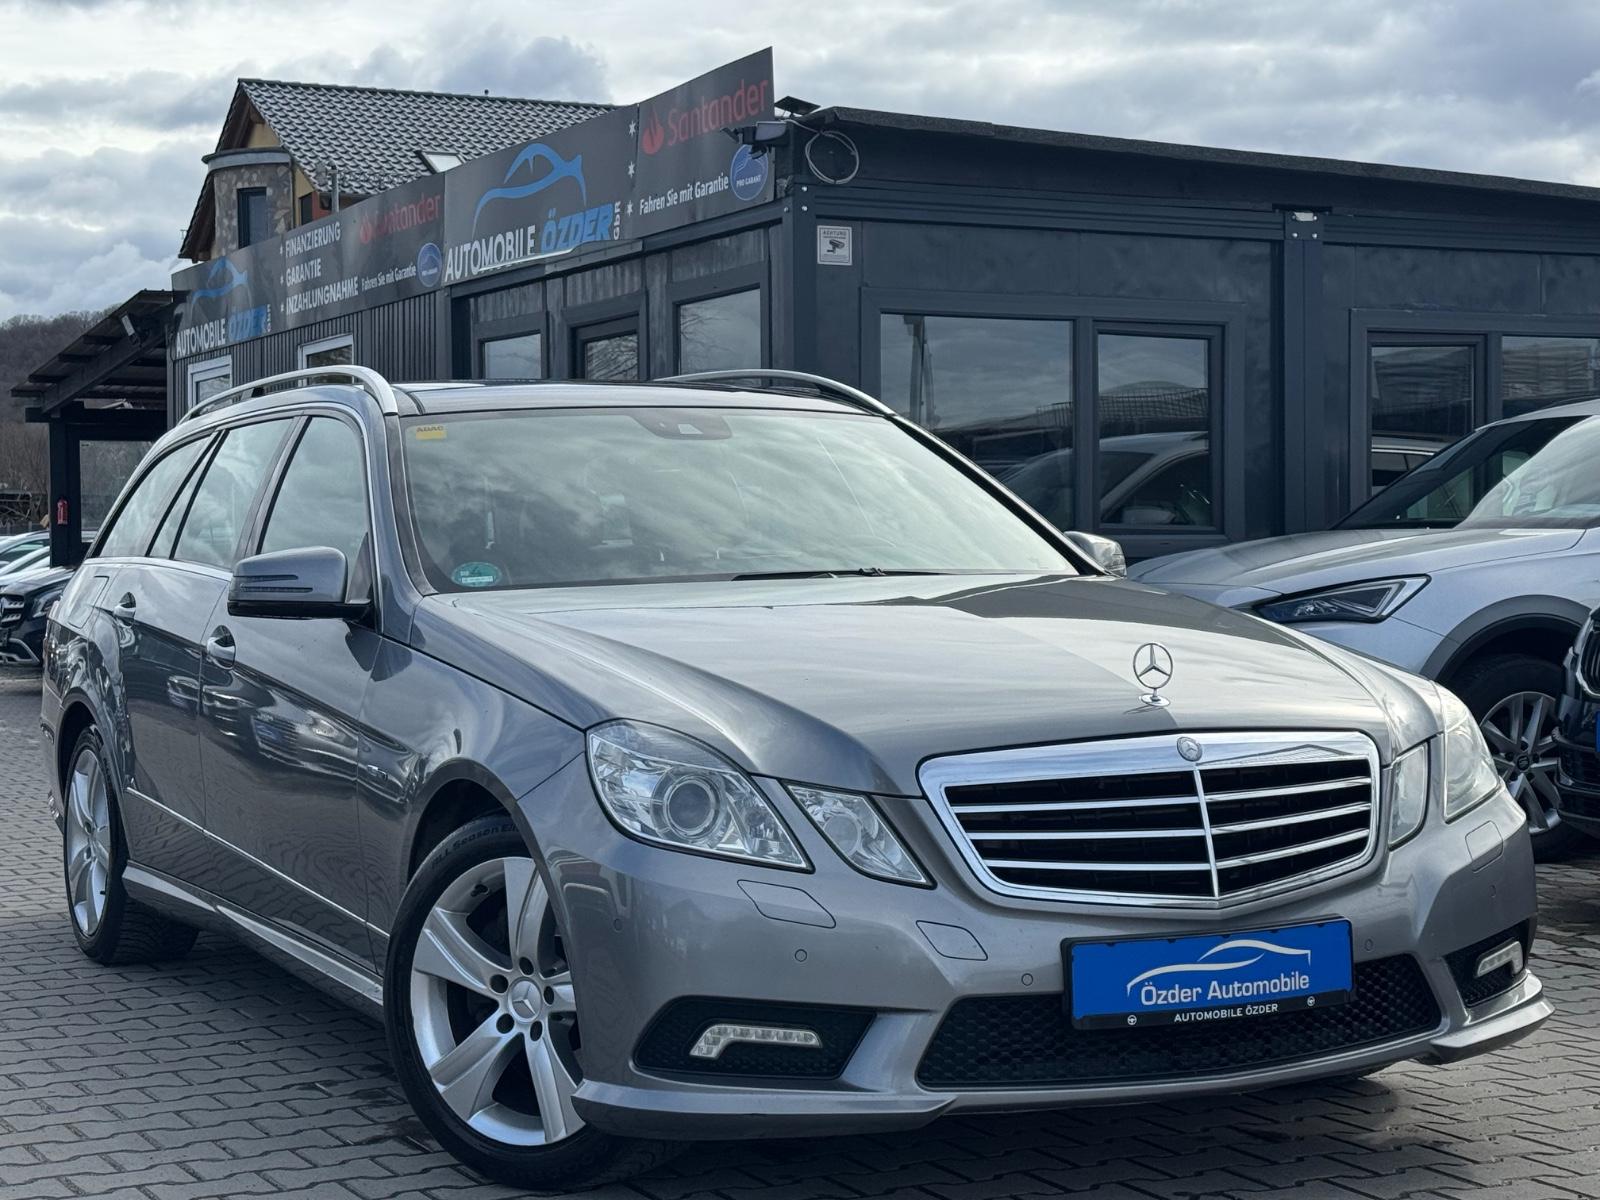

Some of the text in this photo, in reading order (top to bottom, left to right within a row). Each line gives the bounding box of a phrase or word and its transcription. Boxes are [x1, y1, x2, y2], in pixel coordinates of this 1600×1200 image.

[667, 79, 769, 146] Santander
[639, 172, 729, 215] Fahren Sie mit Garantie
[373, 192, 441, 240] ntander
[285, 221, 341, 258] FINANZIERUNG
[444, 204, 613, 282] AUTOMOBILE ÖZDER
[286, 258, 322, 287] GARANTIE
[395, 262, 417, 281] Garantie
[286, 276, 359, 315] INZAHLUNGNAHME
[176, 318, 226, 358] AUTOMOBILE
[1141, 971, 1310, 1006] Özder Automobile
[1174, 1003, 1279, 1022] AUTOMOBILE ÖZDER
